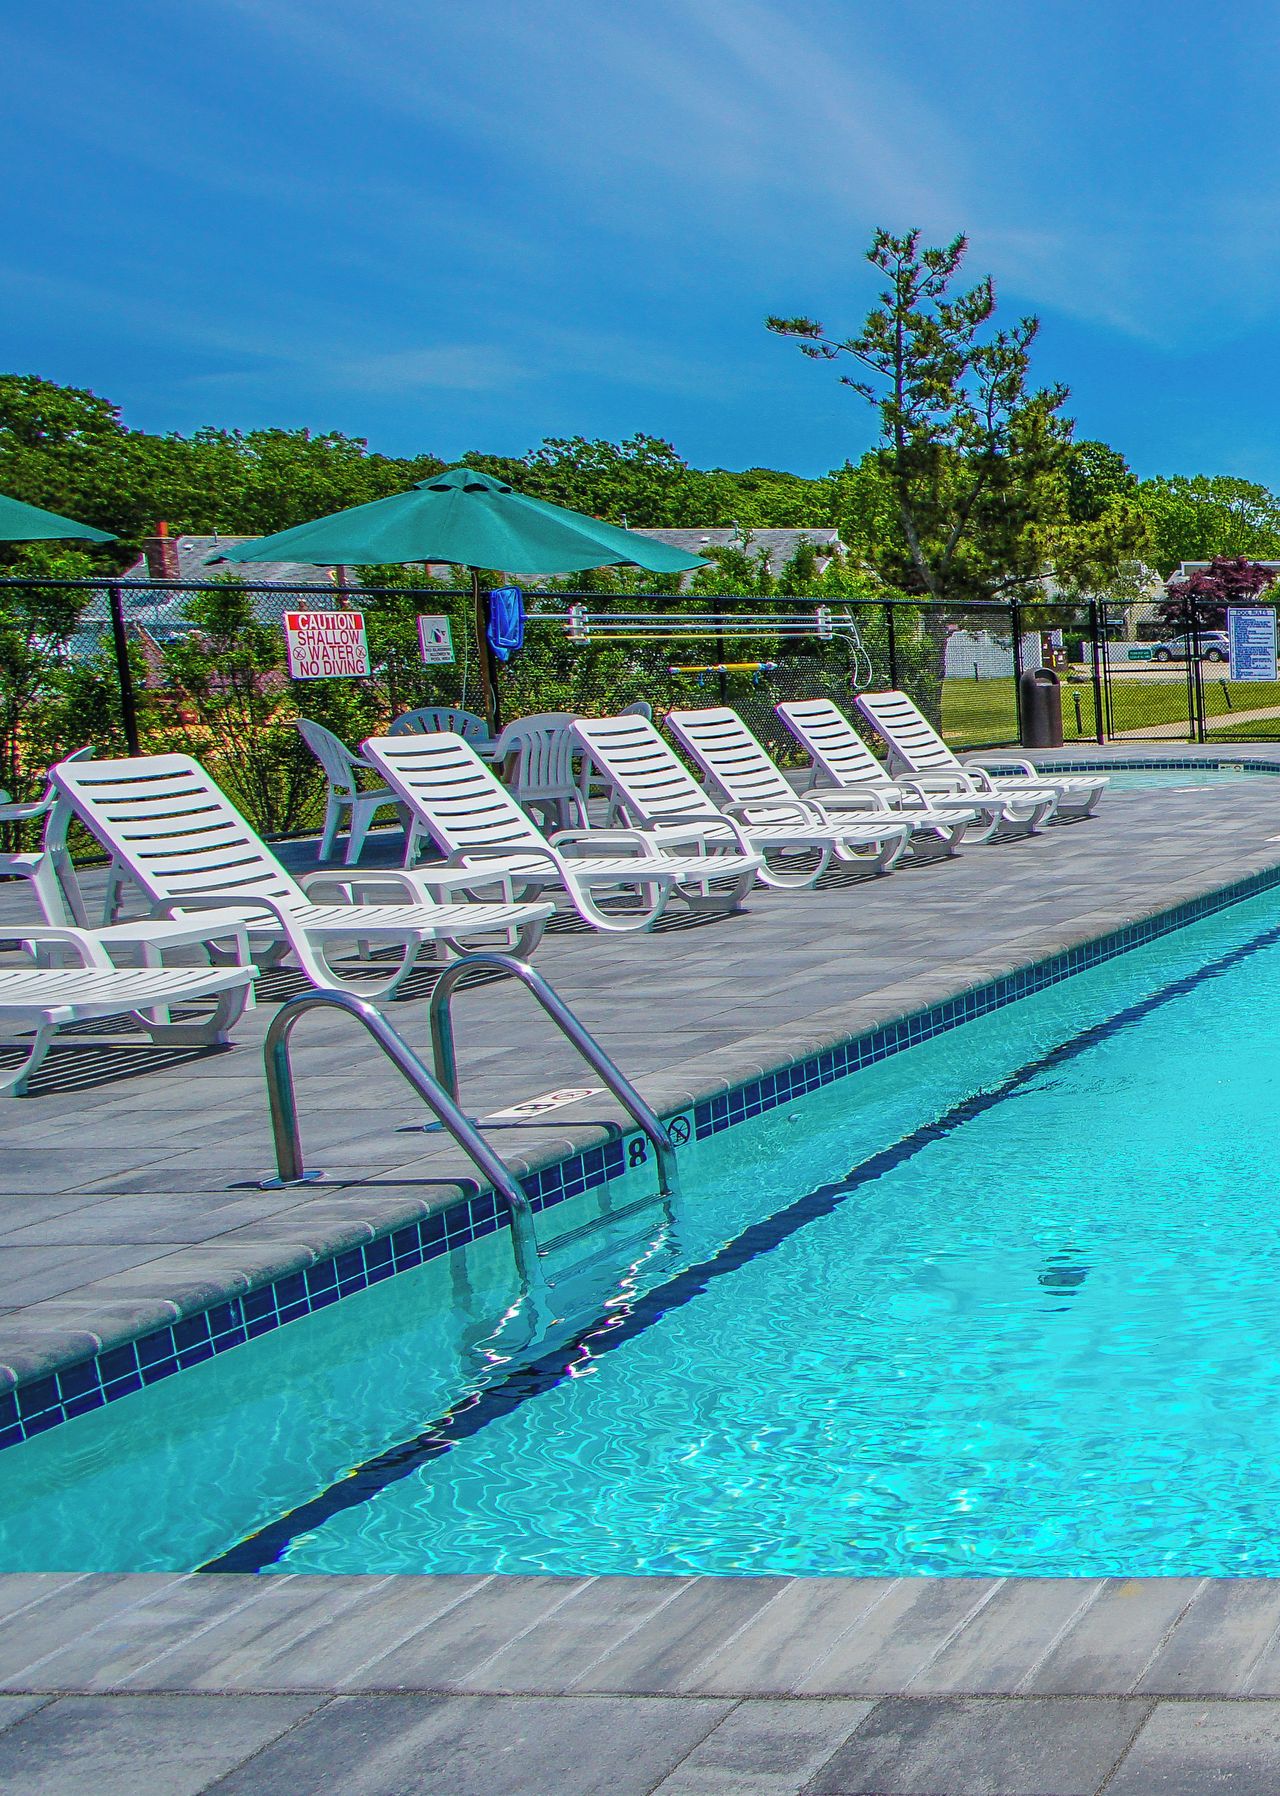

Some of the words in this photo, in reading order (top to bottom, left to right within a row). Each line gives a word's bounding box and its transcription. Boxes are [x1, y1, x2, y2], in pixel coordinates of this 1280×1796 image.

[298, 614, 357, 630] CAUTION
[297, 630, 360, 646] SHALLOW
[308, 645, 354, 660] WATER
[300, 660, 320, 676] NO
[323, 659, 365, 675] DIVING
[628, 1136, 647, 1168] 8
